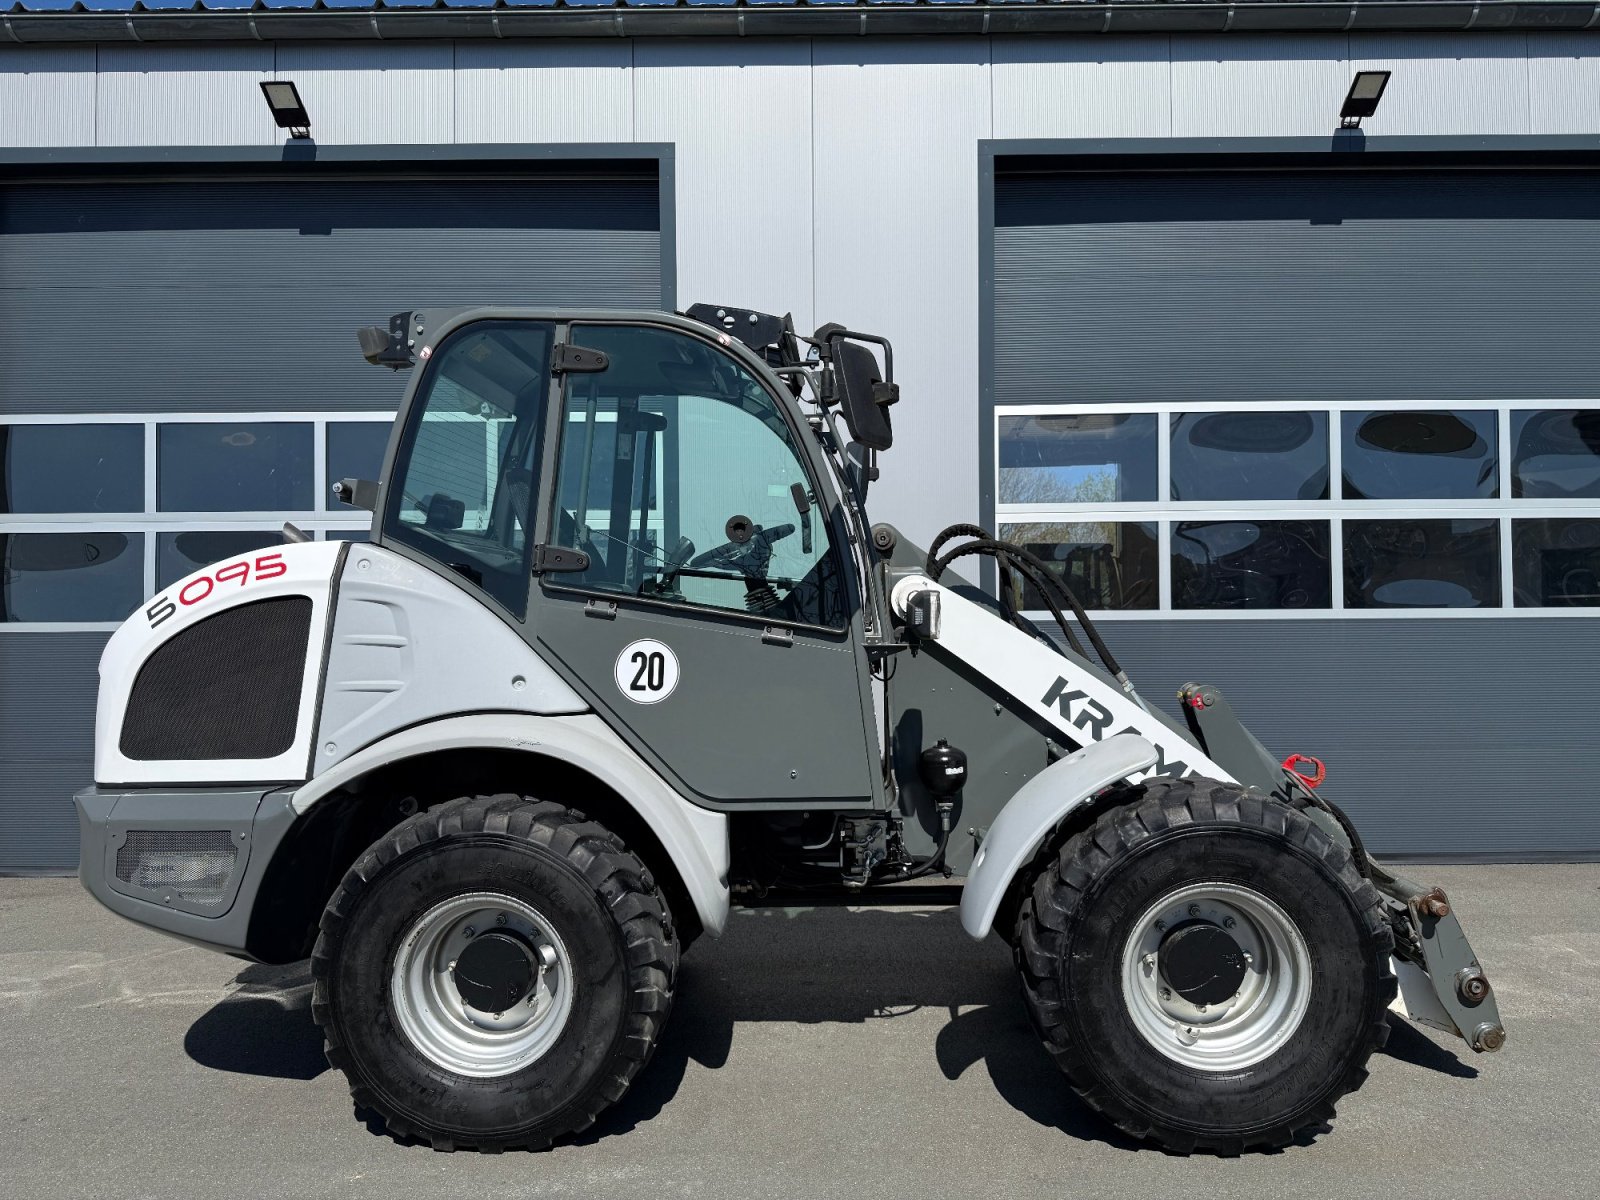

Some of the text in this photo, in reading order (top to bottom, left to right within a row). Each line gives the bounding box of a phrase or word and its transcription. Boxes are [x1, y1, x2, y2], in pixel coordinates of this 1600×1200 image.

[146, 553, 287, 629] 5095
[629, 651, 665, 691] 20
[1040, 675, 1205, 779] KRM
